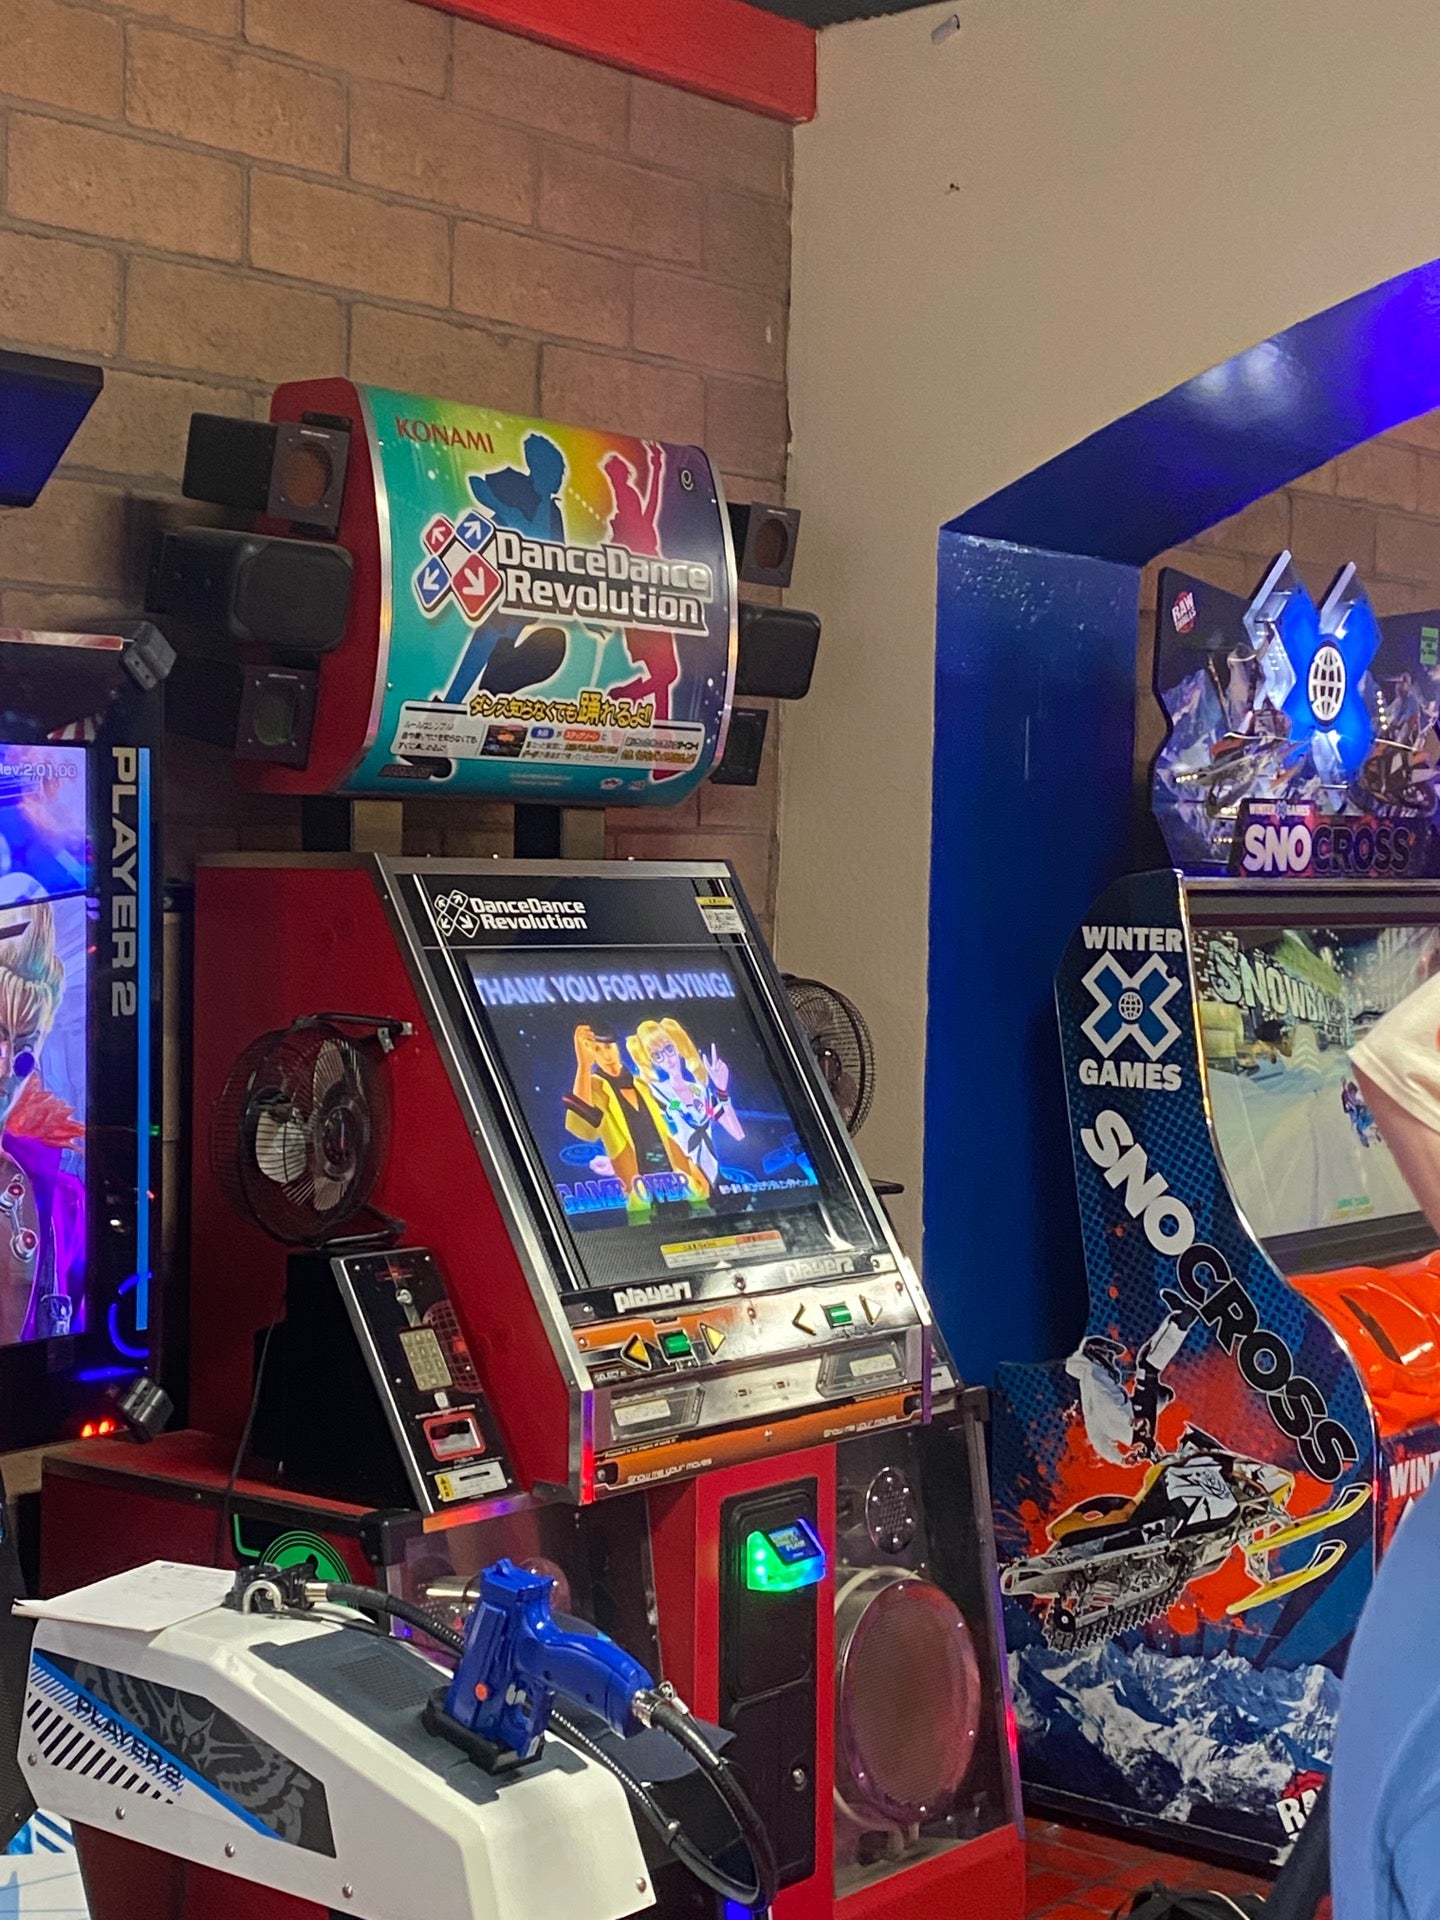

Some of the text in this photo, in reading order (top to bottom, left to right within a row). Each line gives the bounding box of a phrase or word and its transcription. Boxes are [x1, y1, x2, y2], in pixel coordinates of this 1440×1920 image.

[396, 416, 494, 454] KONAMI
[497, 532, 709, 590] DanceDance
[506, 570, 699, 625] Revolution
[111, 747, 137, 1017] PLAYER 2
[470, 898, 586, 914] DanceDance
[481, 914, 588, 930] Revolution
[1082, 926, 1183, 952] WINTER
[474, 972, 735, 1006] THANK YOU FOR PLAYING!
[1079, 1059, 1182, 1091] GAMES
[77, 1695, 164, 1776] PLAYER
[1276, 1786, 1323, 1833] RA
